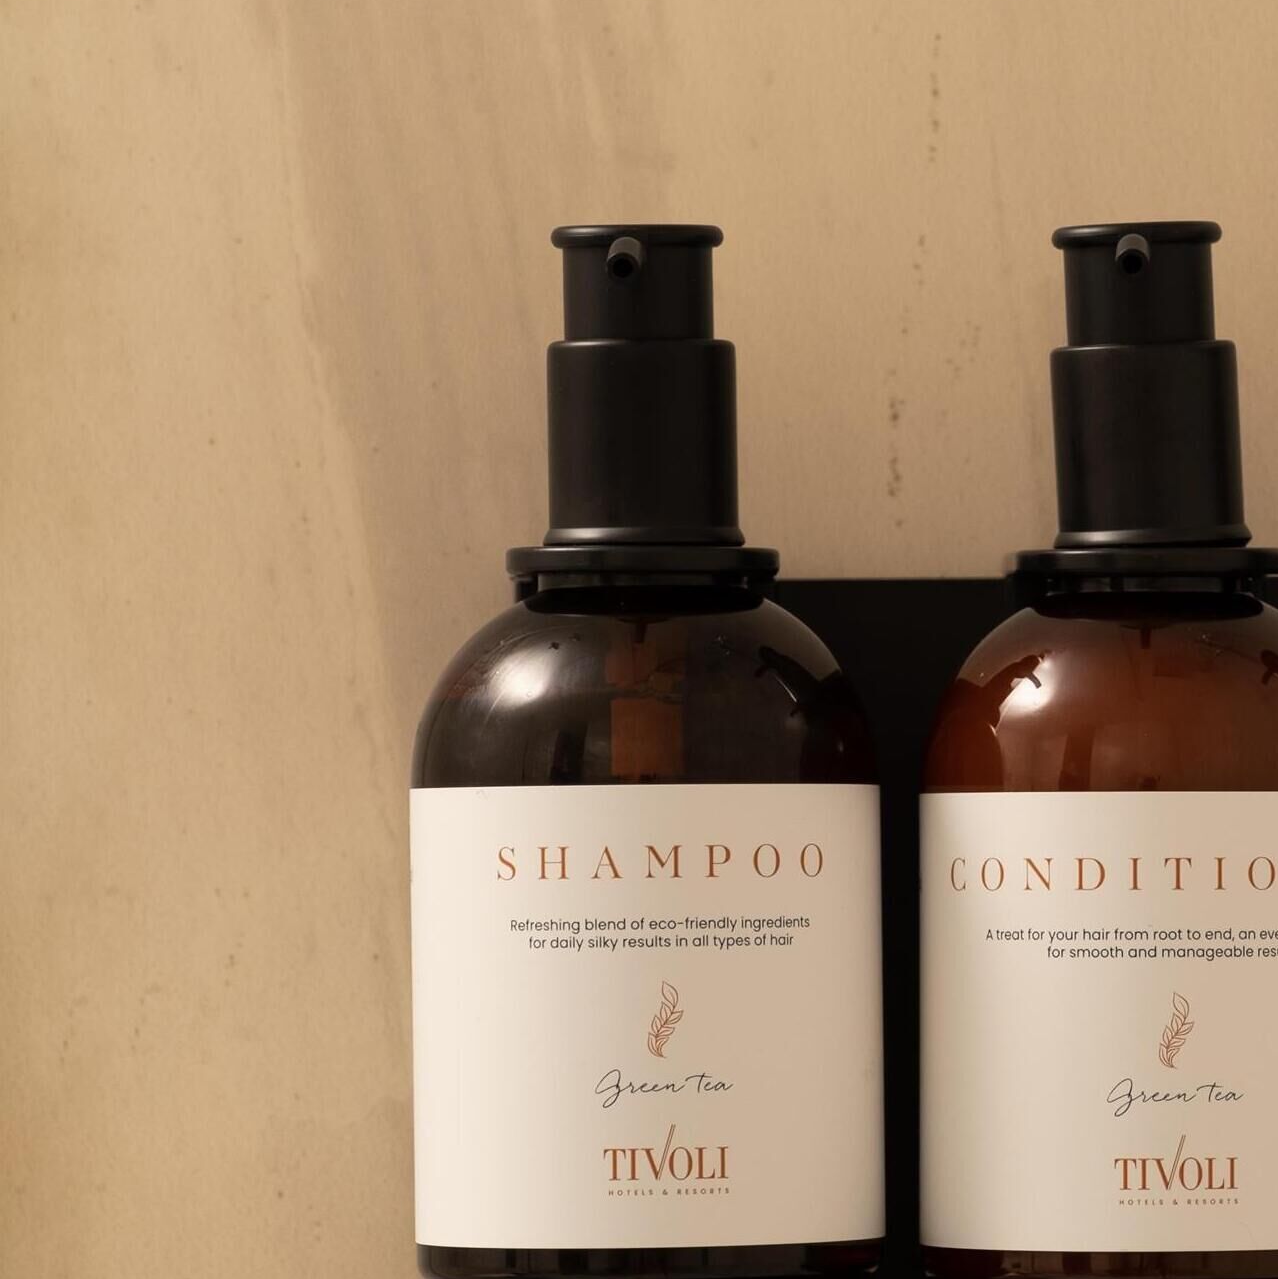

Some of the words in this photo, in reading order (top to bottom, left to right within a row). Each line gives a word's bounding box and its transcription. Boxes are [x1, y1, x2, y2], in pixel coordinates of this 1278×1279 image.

[496, 842, 824, 881] SHAMPOO
[510, 918, 581, 935] Refreshing
[584, 918, 627, 932] blend
[630, 917, 645, 932] of
[648, 917, 738, 935] eco-friendly
[740, 916, 811, 934] ingredients
[528, 936, 548, 949] for
[549, 936, 585, 952] daily
[587, 936, 619, 952] silky
[622, 935, 672, 948] results
[675, 935, 688, 948] in
[692, 934, 709, 948] all
[712, 935, 752, 951] types
[753, 934, 767, 947] of
[769, 934, 794, 947] hair
[985, 929, 994, 940] A
[995, 929, 1025, 940] treat
[1027, 928, 1045, 940] for
[1048, 930, 1079, 944] your
[1082, 928, 1110, 940] hair
[1113, 928, 1149, 940] from
[1152, 929, 1183, 940] root
[1185, 929, 1202, 940] to
[1204, 928, 1236, 942] end,
[1237, 930, 1257, 940] an
[1047, 945, 1067, 959] for
[1068, 945, 1124, 959] smooth
[1127, 945, 1158, 959] and
[1161, 945, 1255, 962] manageable
[595, 1069, 684, 1109] Green
[684, 1074, 733, 1093] Tea
[1107, 1078, 1193, 1117] Green
[1196, 1082, 1243, 1103] Tea
[603, 1123, 728, 1181] TIVOLI
[1114, 1134, 1238, 1190] TIVOLI
[608, 1188, 654, 1197] HOTELS
[676, 1186, 730, 1196] RESORTS
[1118, 1198, 1164, 1207] HOTELS
[1186, 1197, 1239, 1206] RESORTS
